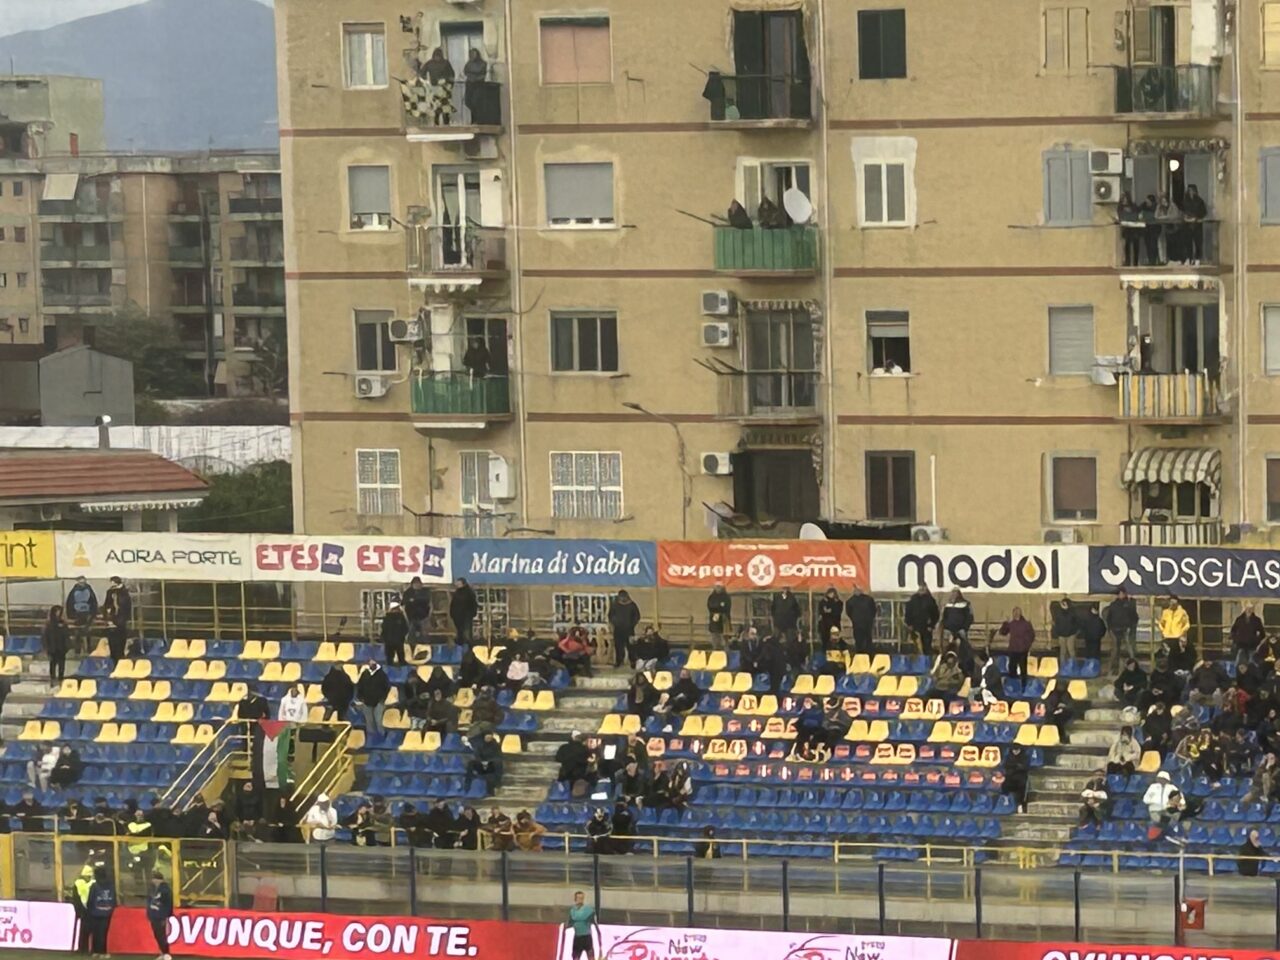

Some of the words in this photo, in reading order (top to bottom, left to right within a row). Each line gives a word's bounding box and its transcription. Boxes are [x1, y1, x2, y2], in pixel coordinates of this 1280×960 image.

[0, 534, 38, 568] int
[105, 548, 166, 563] ADRA
[256, 544, 319, 571] ETES
[357, 545, 421, 572] ETES
[469, 552, 543, 574] Marina
[547, 550, 568, 573] di
[572, 550, 640, 575] Stabia
[898, 549, 1059, 589] madol
[343, 923, 418, 954] CON
[427, 926, 478, 956] TE.
